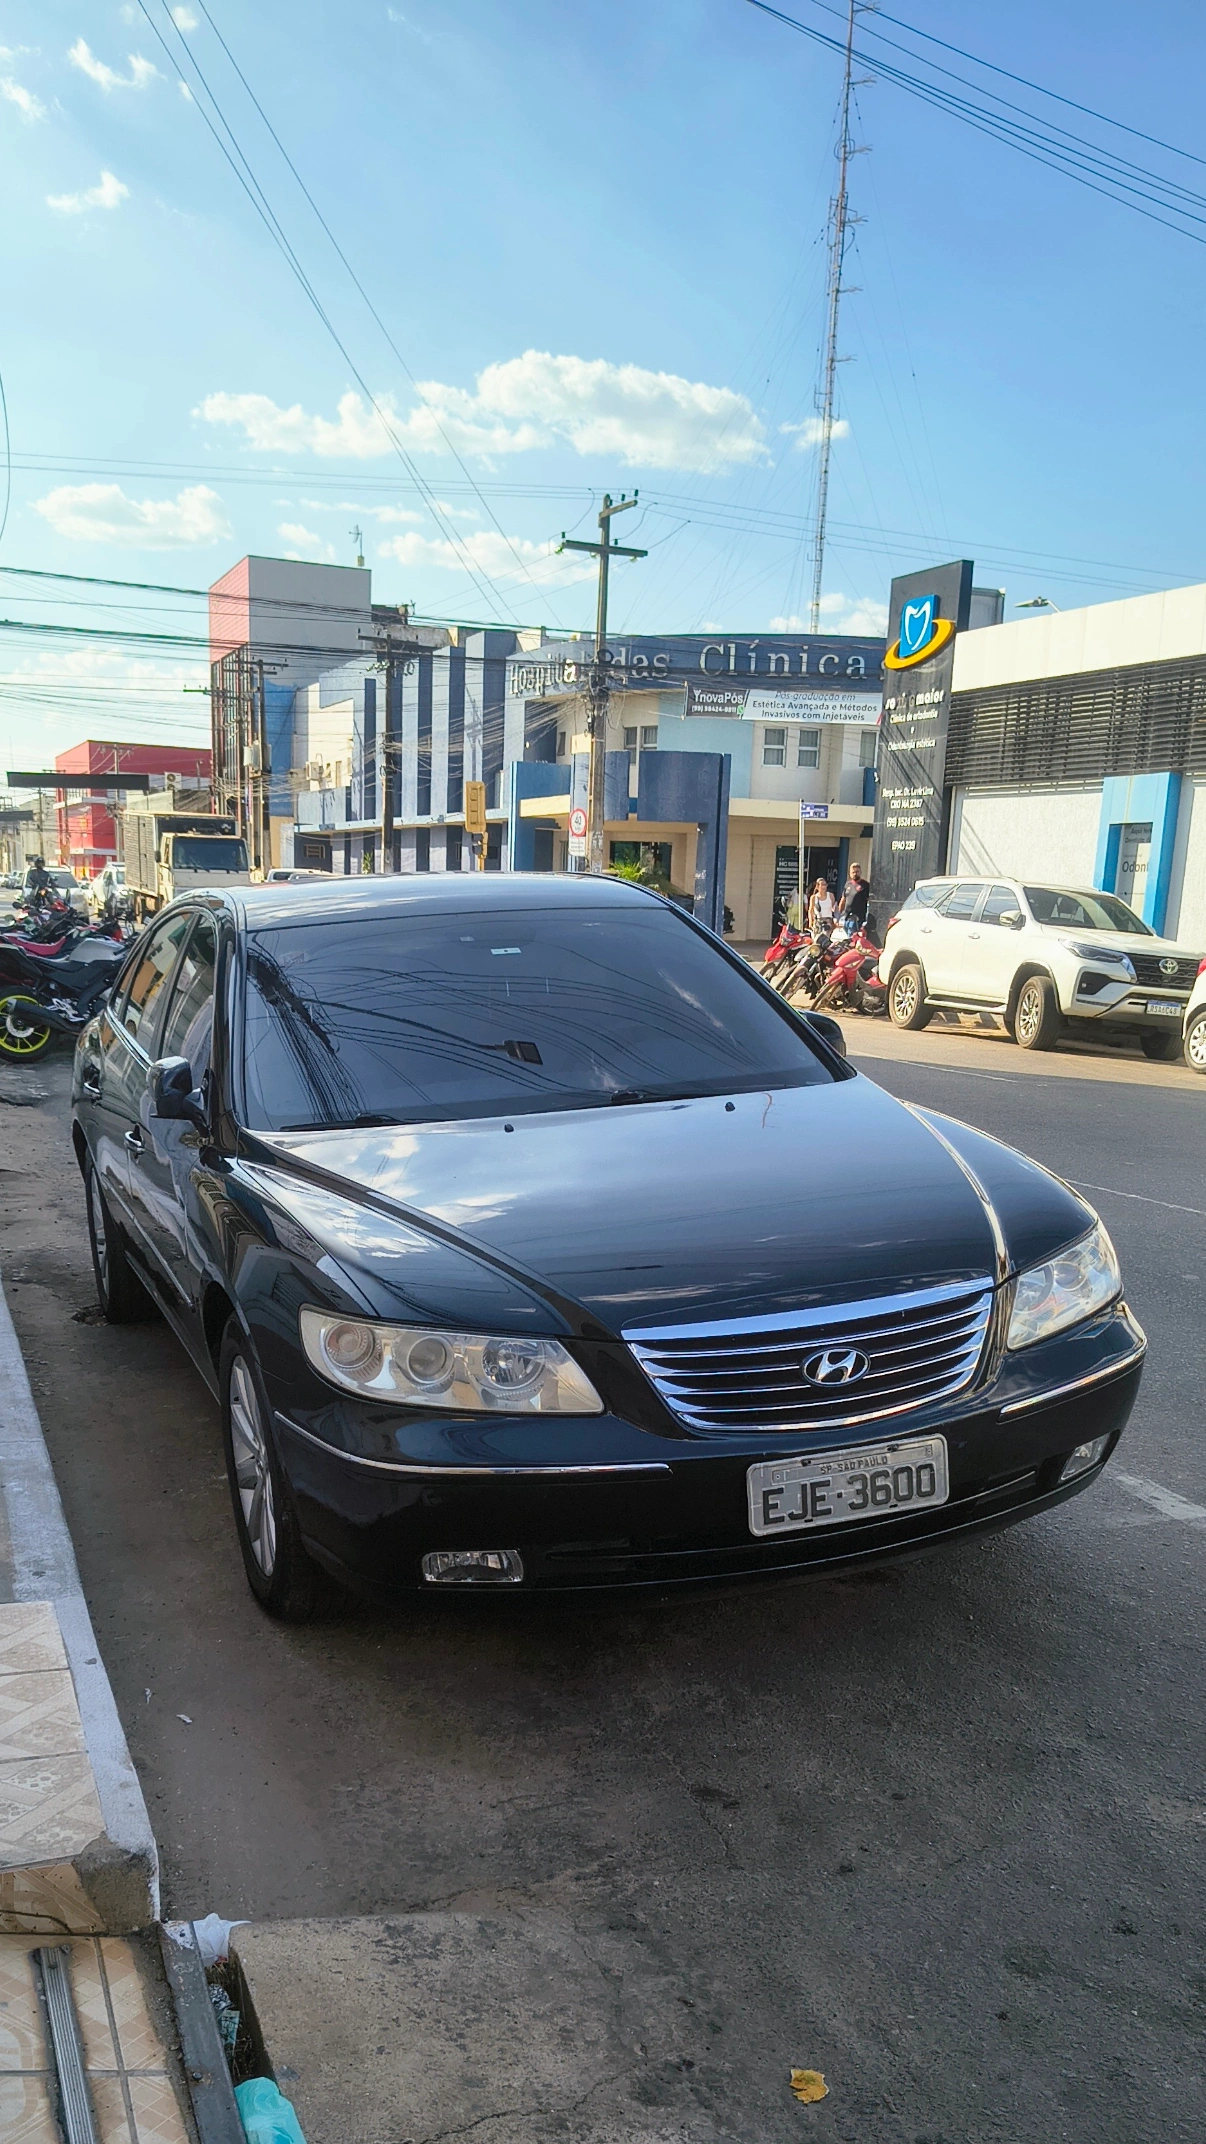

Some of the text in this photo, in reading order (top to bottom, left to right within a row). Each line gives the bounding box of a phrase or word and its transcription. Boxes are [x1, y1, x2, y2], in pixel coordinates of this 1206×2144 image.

[841, 694, 856, 702] em
[753, 700, 786, 709] Estética
[788, 702, 829, 712] Avançada
[839, 702, 878, 713] Métodos
[761, 710, 865, 722] Invasivos com Injetáveis
[857, 1455, 888, 1469] PAULO
